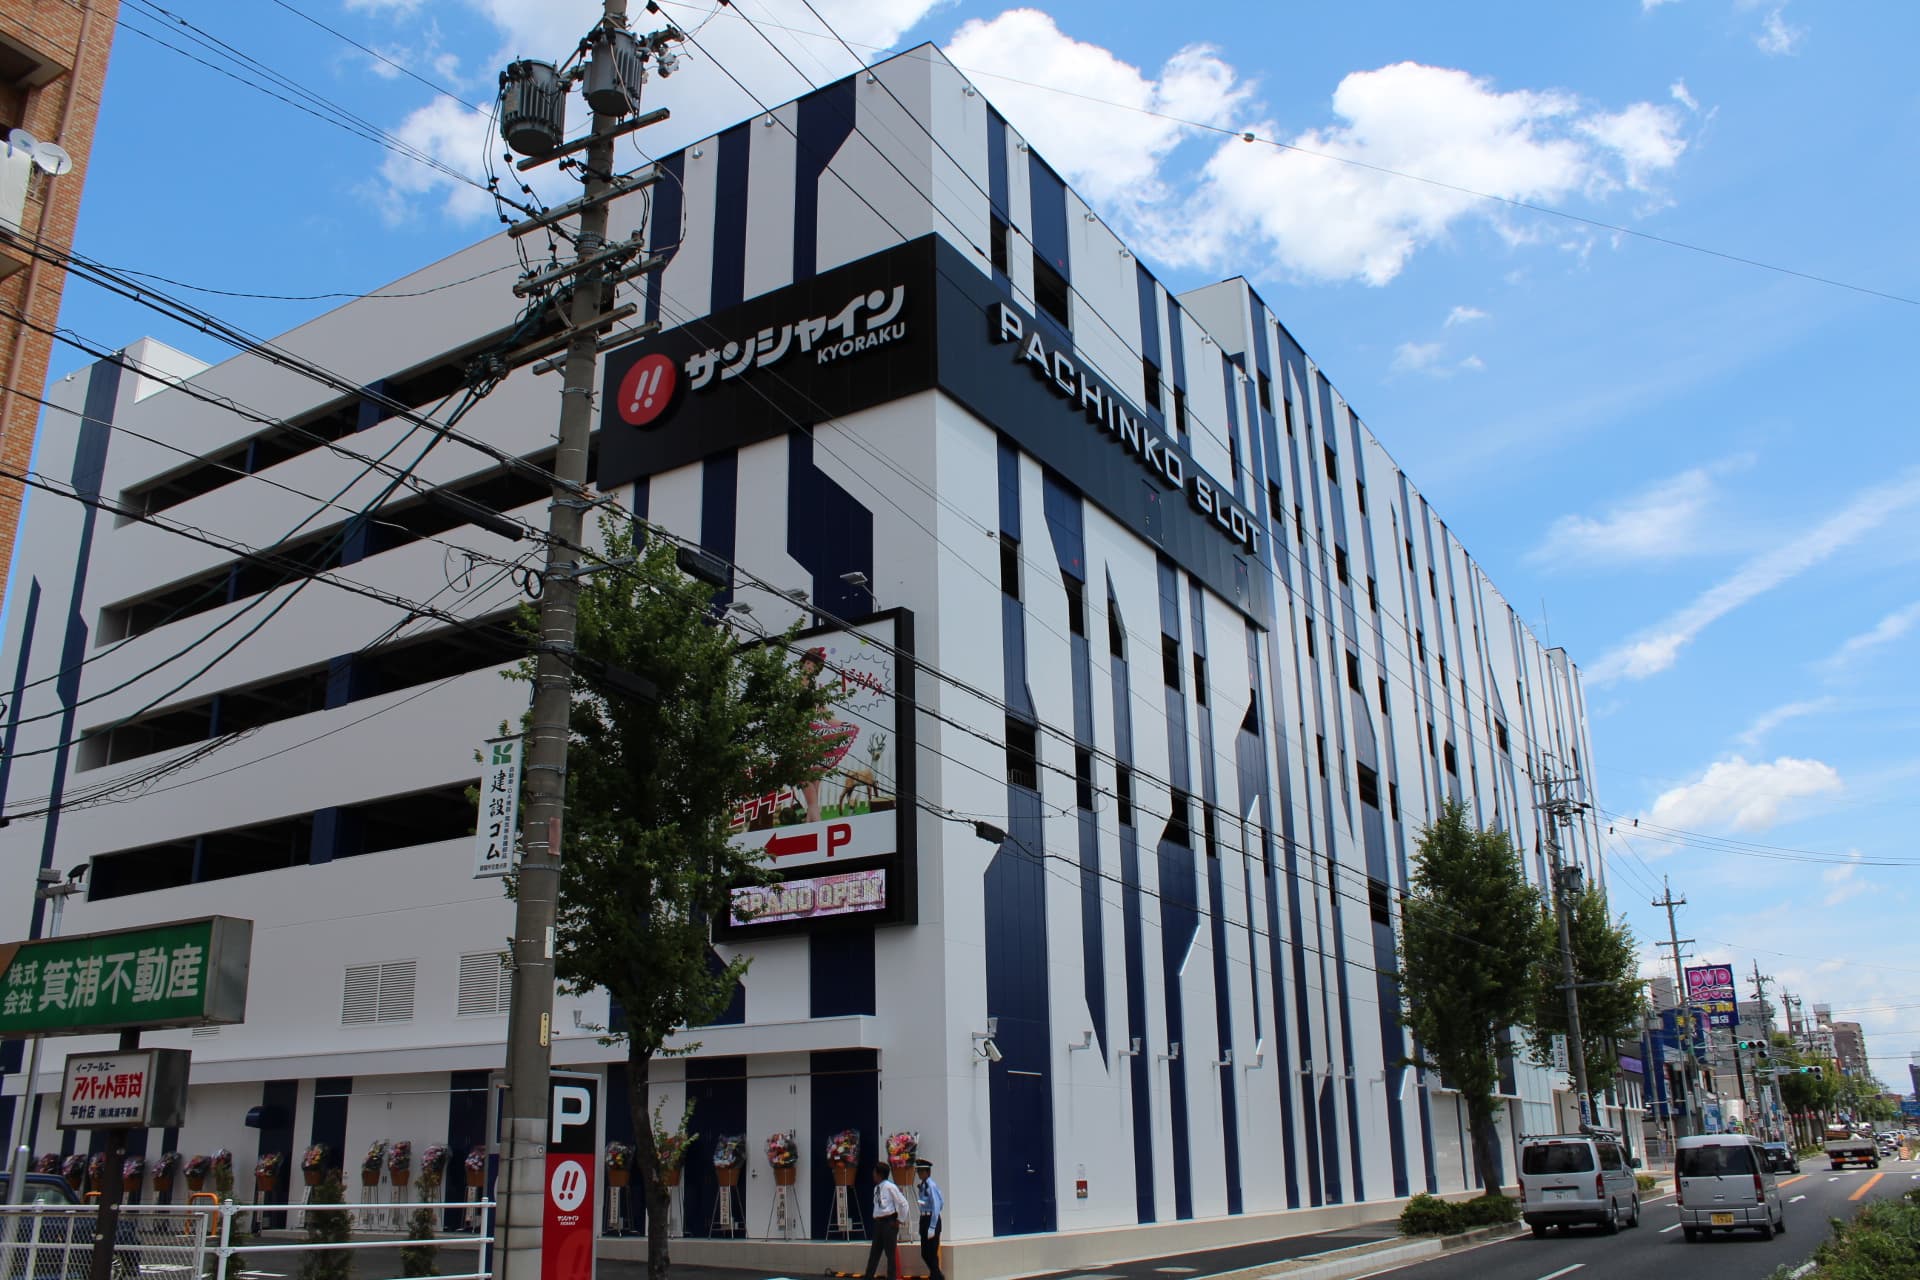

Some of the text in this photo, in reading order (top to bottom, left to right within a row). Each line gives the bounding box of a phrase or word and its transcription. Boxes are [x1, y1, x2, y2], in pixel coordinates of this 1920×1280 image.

[685, 285, 905, 391] サンシャイン
[817, 321, 907, 365] KYORAKU
[999, 302, 1261, 554] PACHINKO SLOT
[487, 769, 508, 861] 建設ゴム
[827, 822, 852, 857] P
[734, 877, 883, 917] GRAND OPEN
[8, 943, 203, 1012] 株式 箕浦不動産
[1688, 968, 1731, 987] DVD
[3, 989, 33, 1015] 会社
[70, 1105, 96, 1120] 平針店
[552, 1085, 590, 1144] P
